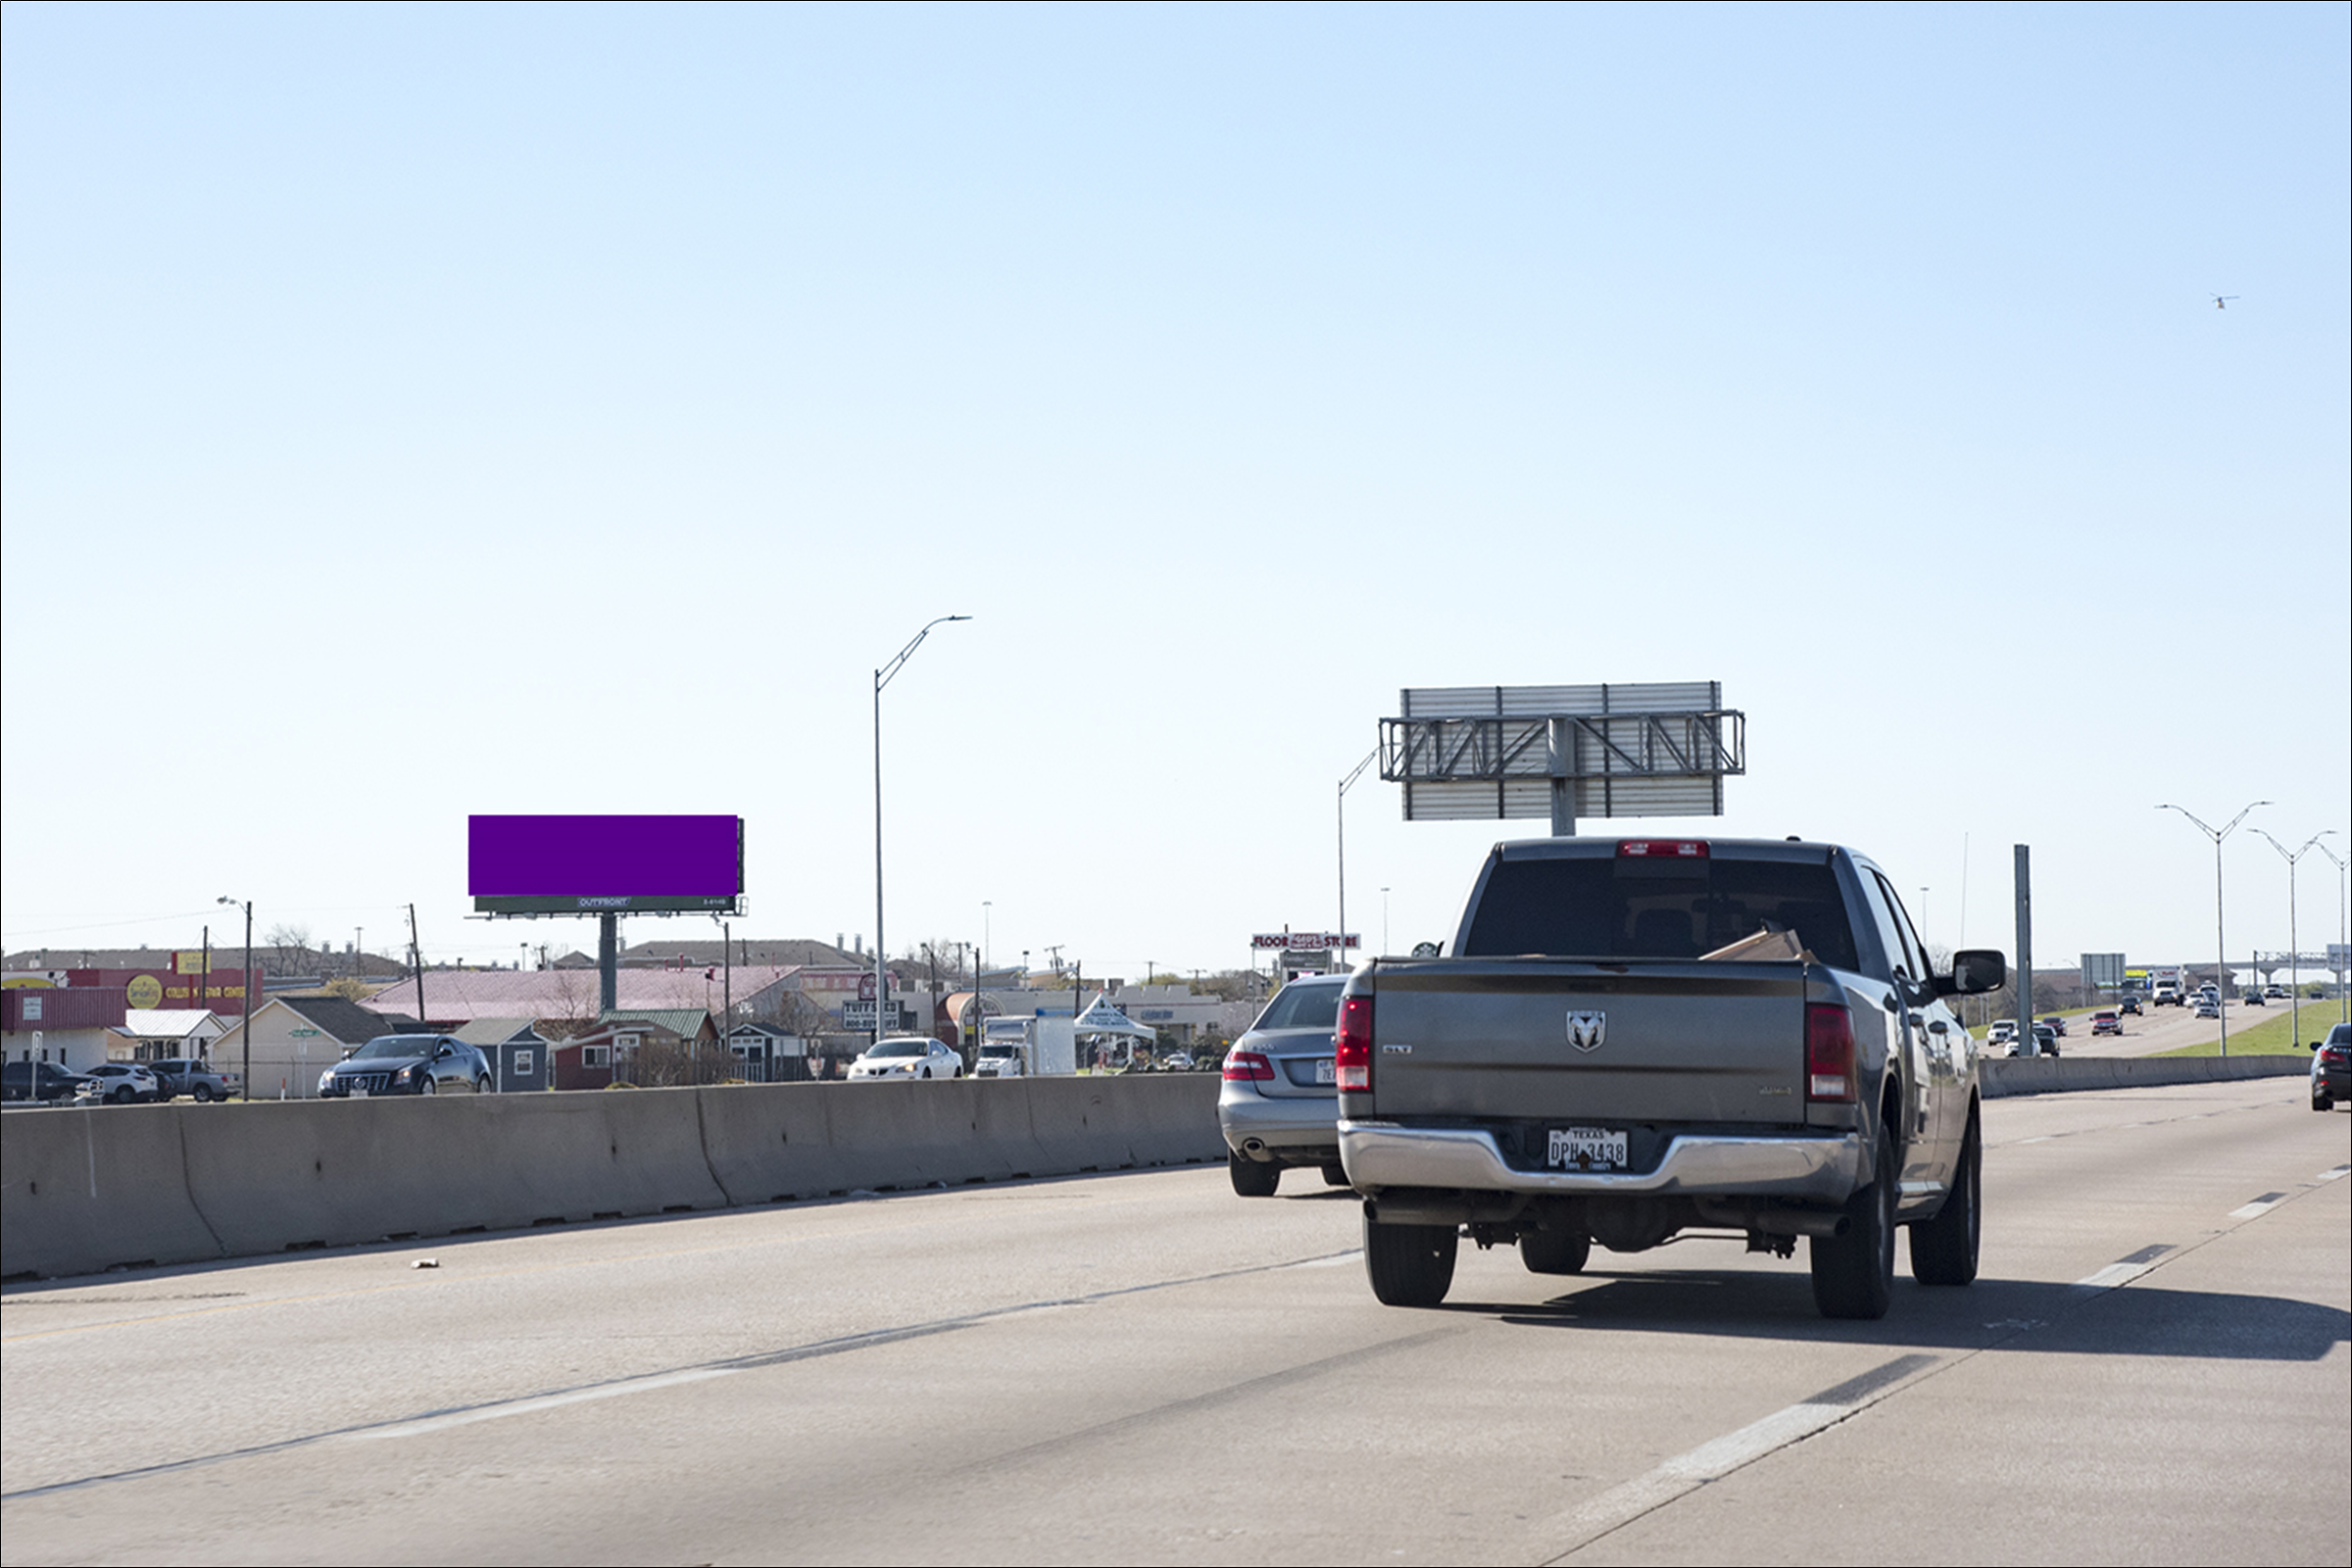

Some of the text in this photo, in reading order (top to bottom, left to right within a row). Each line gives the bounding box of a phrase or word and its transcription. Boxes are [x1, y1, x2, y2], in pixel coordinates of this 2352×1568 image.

[579, 897, 629, 906] OUTFRONT
[1254, 936, 1289, 948] FLOOR
[844, 1002, 897, 1013] TUFF SED
[1573, 1130, 1605, 1140] TEXAS
[1551, 1142, 1625, 1163] DPH 3438
